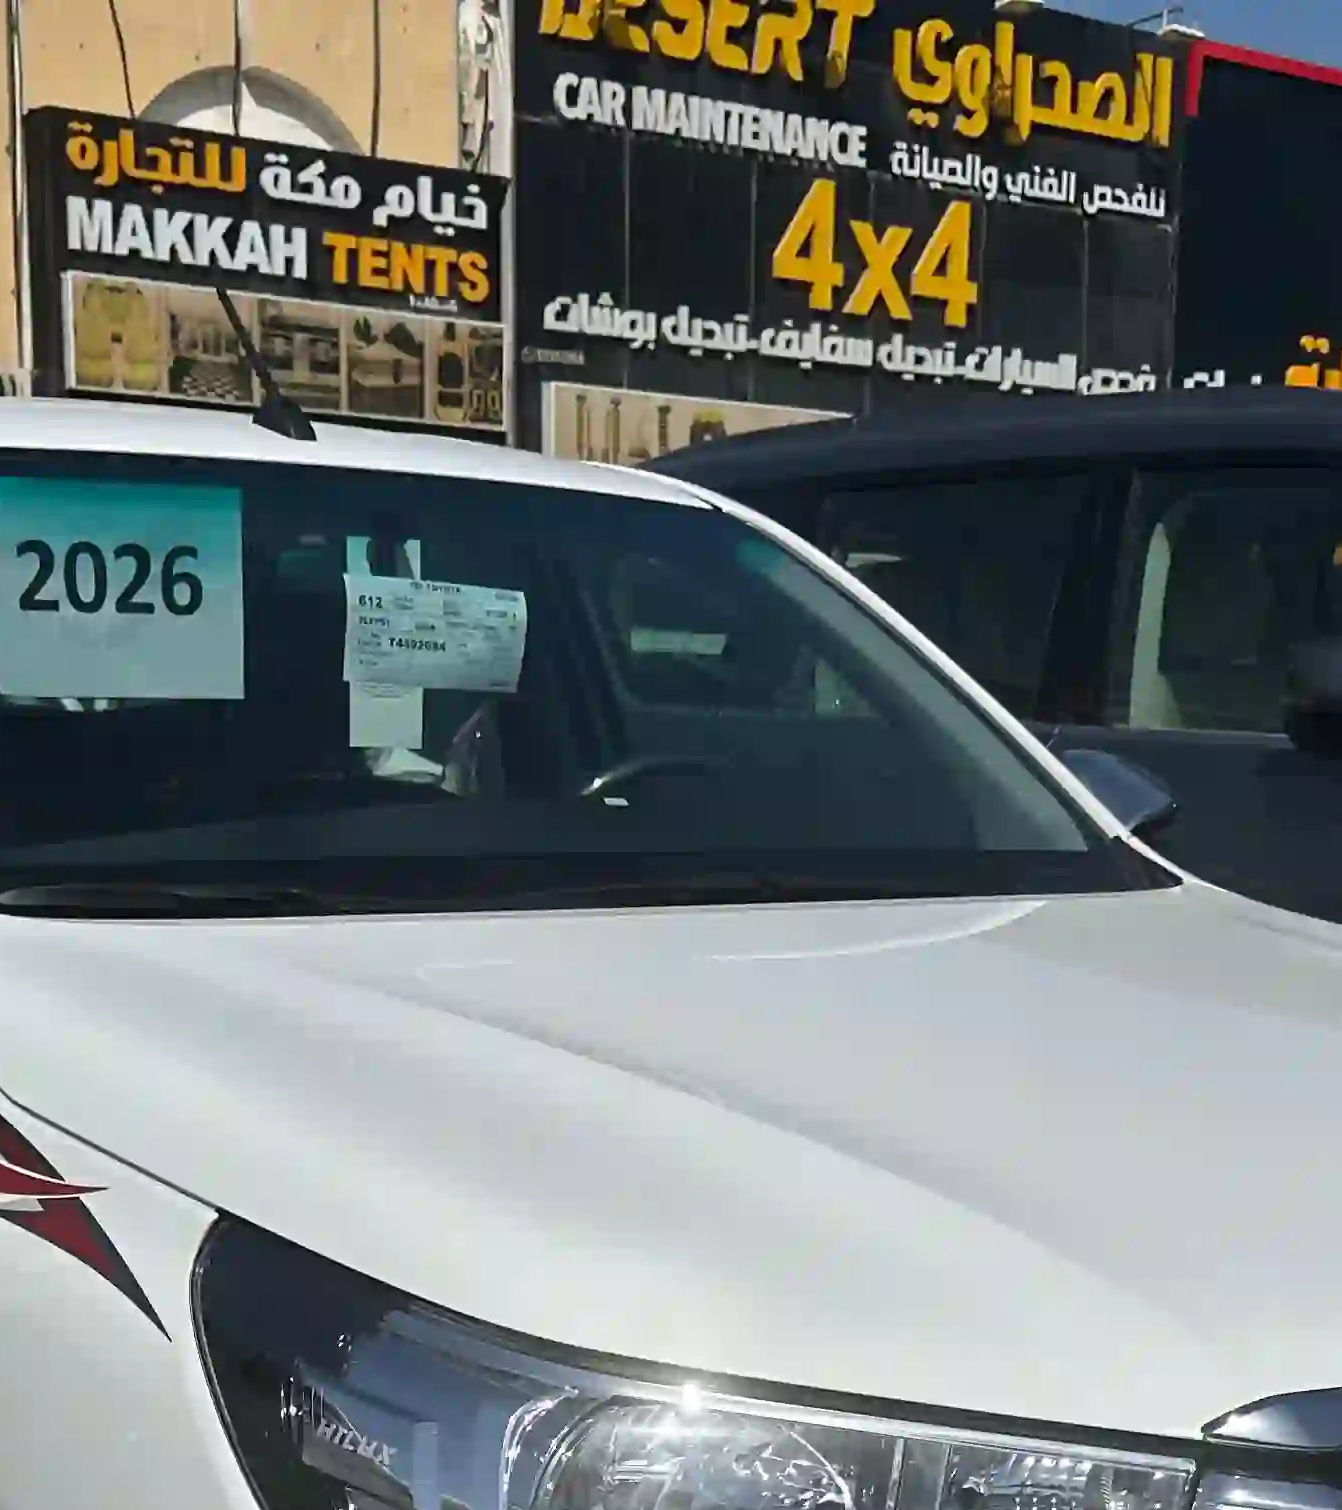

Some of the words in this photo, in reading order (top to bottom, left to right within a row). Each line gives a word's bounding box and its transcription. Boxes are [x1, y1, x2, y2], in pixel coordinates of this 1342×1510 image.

[892, 20, 1172, 148] الصحراوي
[555, 73, 625, 128] CAR
[632, 89, 868, 167] MAINTENANCE
[66, 121, 246, 194] للتجارة
[260, 152, 361, 209] مكة
[890, 141, 999, 201] والصيانة
[1005, 165, 1077, 205] الفني
[373, 177, 488, 235] خيام
[1083, 183, 1166, 218] للفحص
[66, 196, 308, 279] MAKKAH
[322, 231, 491, 302] TENTS
[772, 178, 978, 328] 4x4
[15, 538, 204, 616] 2026
[358, 594, 384, 610] 612
